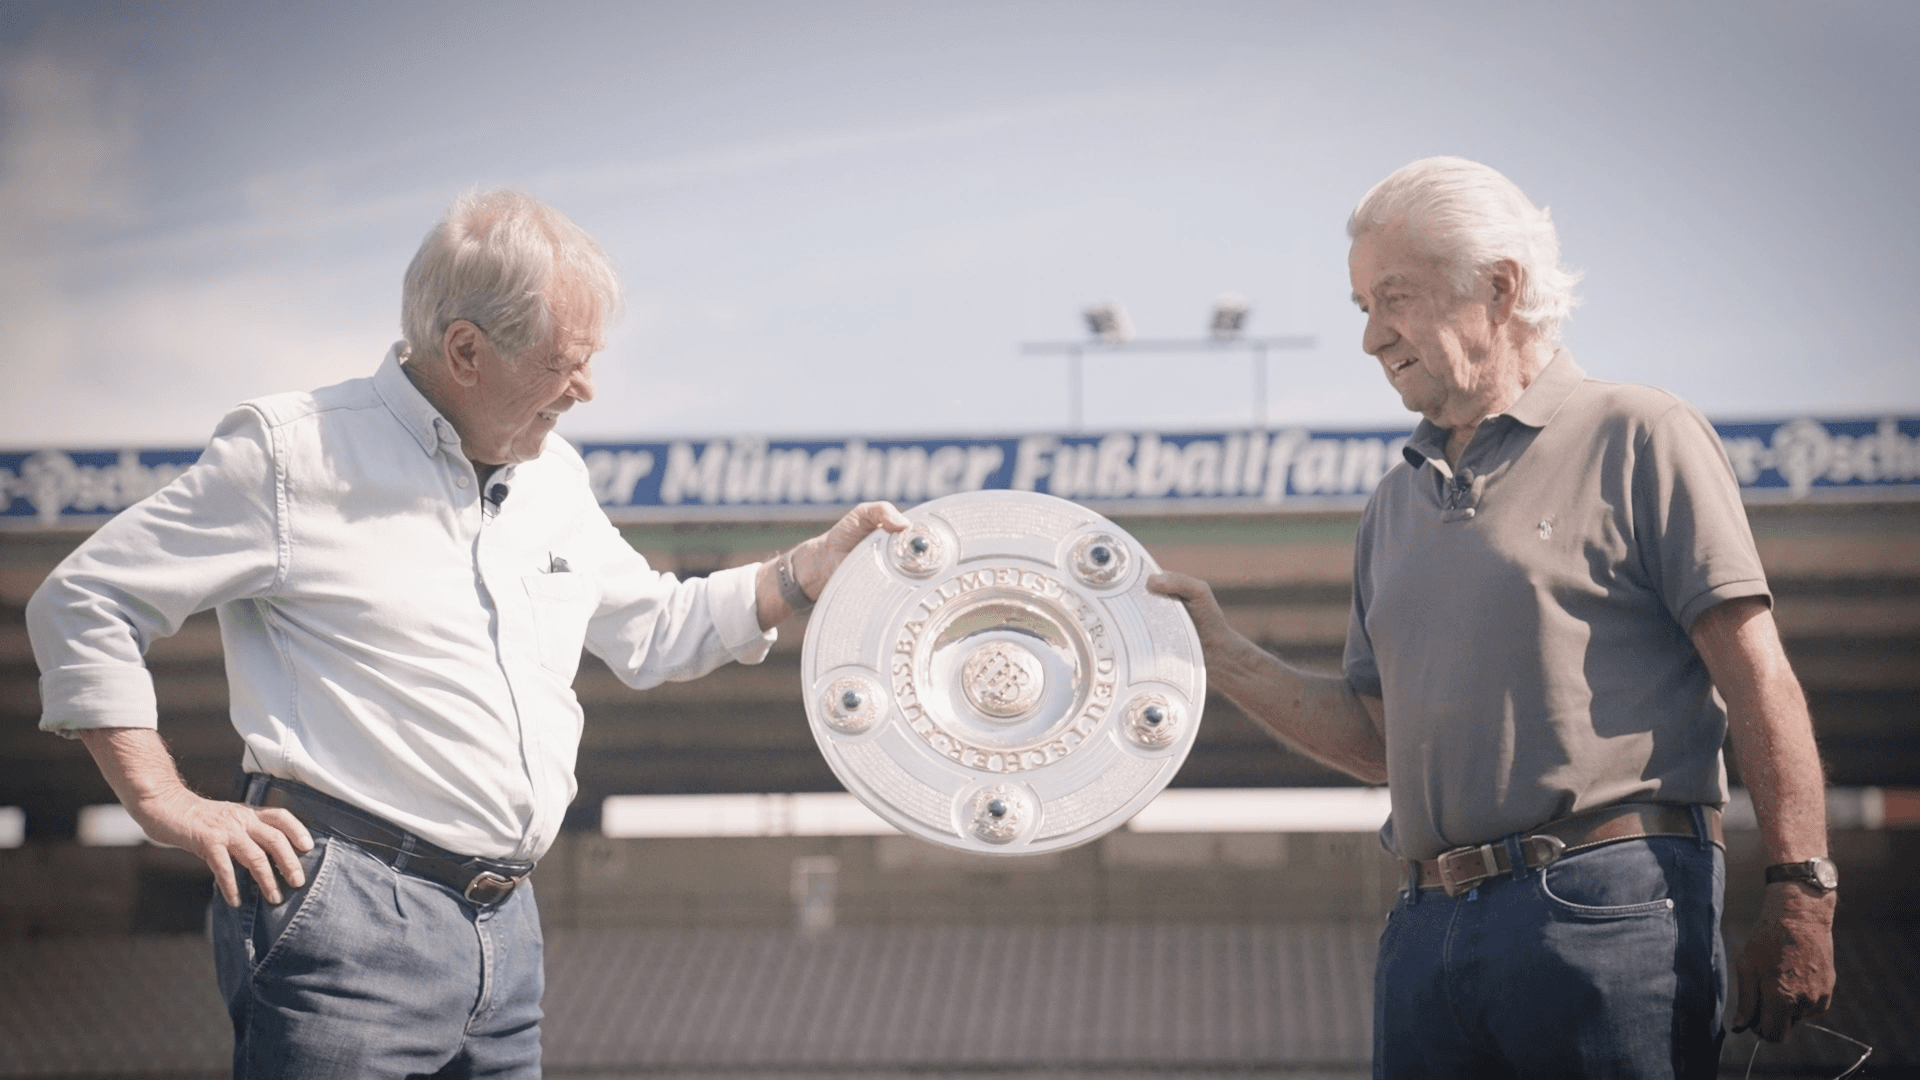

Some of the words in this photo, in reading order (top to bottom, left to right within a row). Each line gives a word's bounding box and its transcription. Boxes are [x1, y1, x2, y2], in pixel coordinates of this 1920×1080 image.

[0, 447, 193, 522] -Pscho
[577, 444, 655, 504] er
[660, 438, 1004, 504] Münchner
[1719, 417, 1920, 499] r-Psch
[948, 657, 1114, 772] DEUTSCHER
